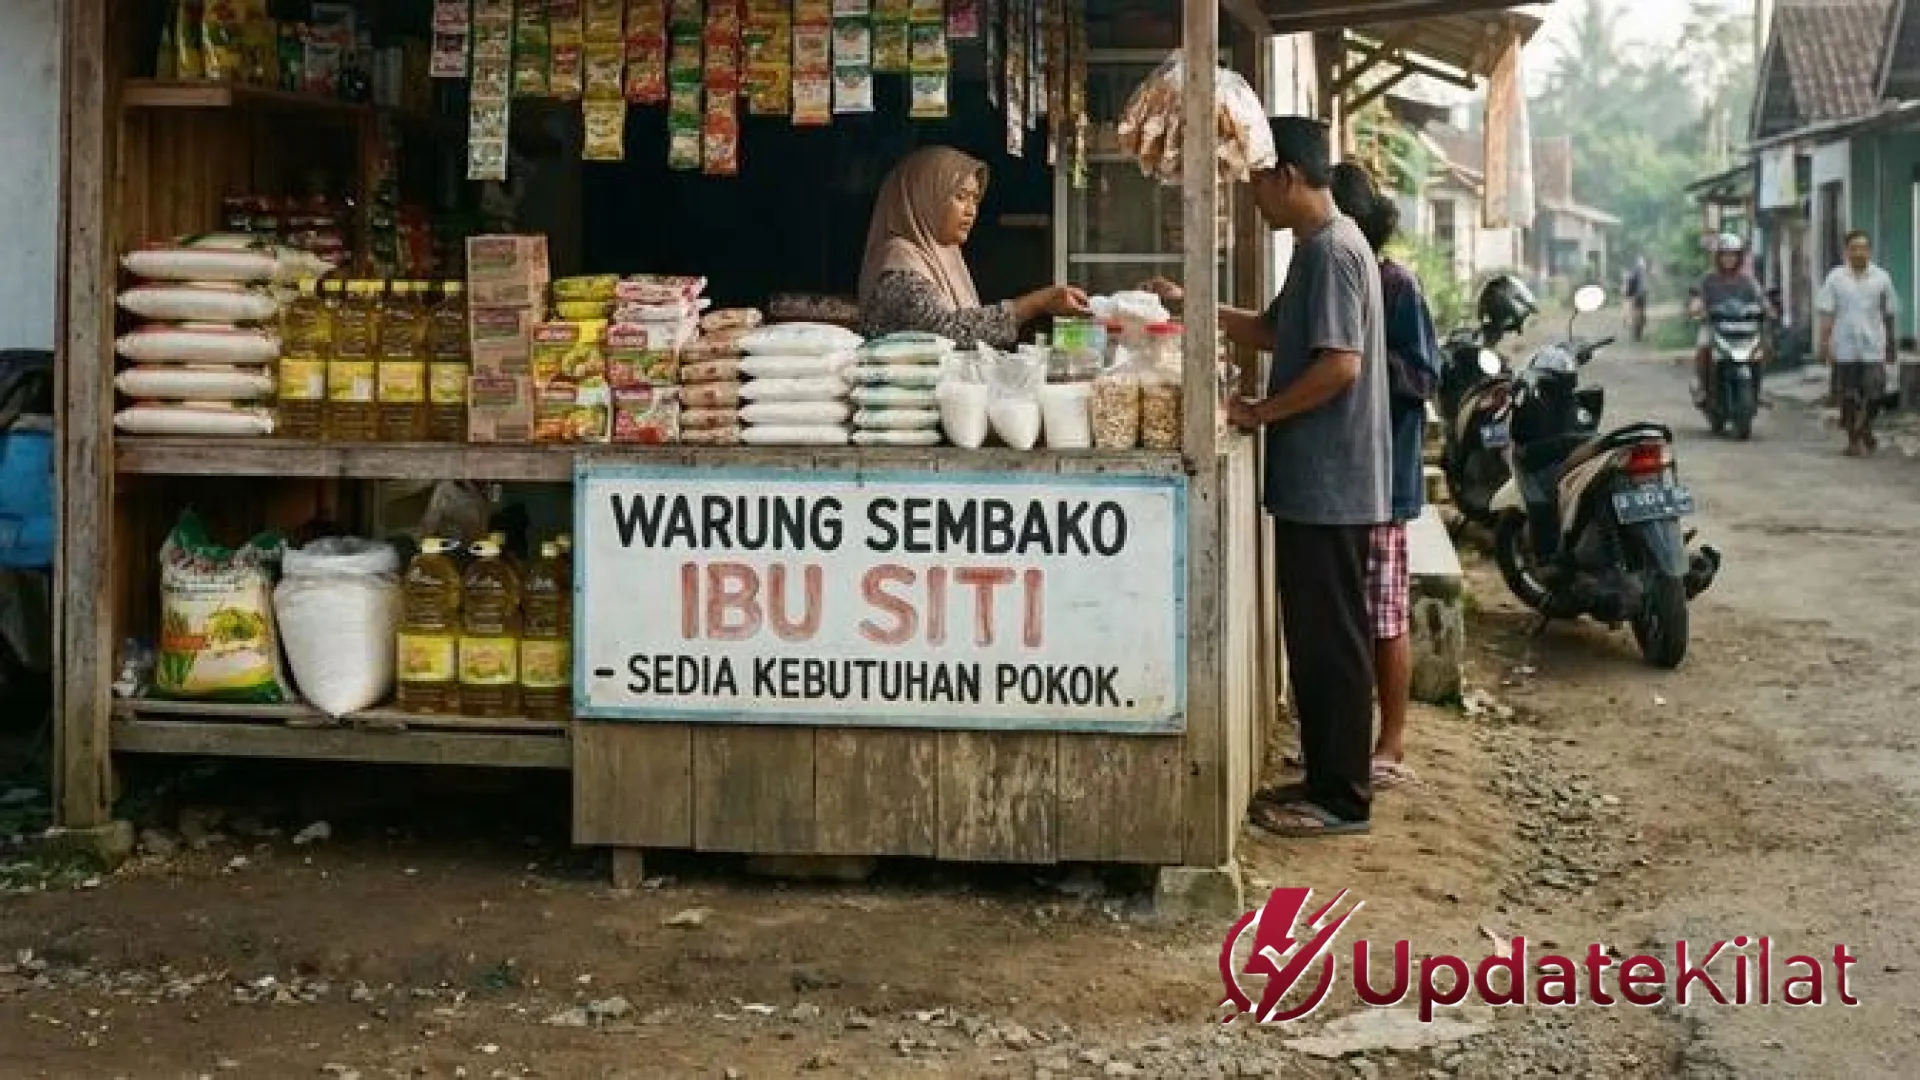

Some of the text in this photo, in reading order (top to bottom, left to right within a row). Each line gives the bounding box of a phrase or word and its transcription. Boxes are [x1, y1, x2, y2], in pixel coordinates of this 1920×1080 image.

[610, 493, 1127, 556] WARUNG SEMBAKO
[681, 561, 1043, 647] IBU SITI
[627, 655, 738, 696] SEDIA
[754, 657, 981, 703] KEBUTUHAN
[996, 664, 1135, 707] POKOK.
